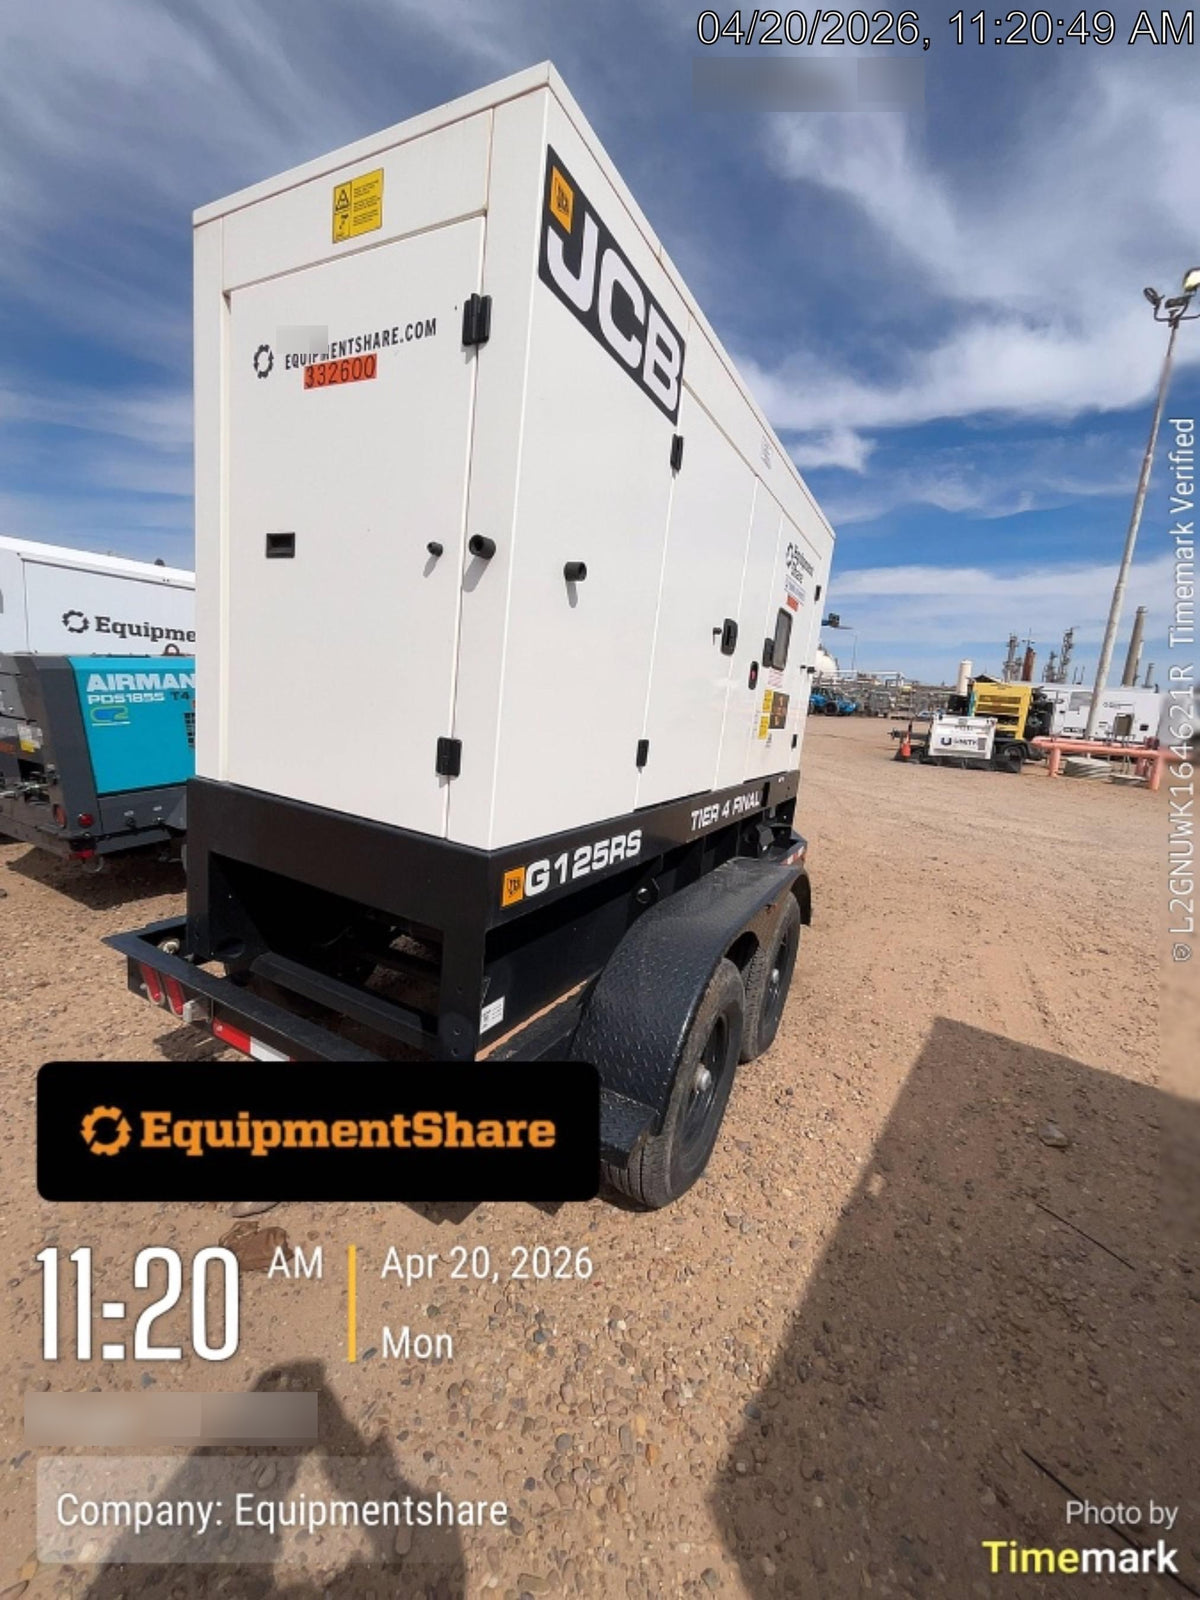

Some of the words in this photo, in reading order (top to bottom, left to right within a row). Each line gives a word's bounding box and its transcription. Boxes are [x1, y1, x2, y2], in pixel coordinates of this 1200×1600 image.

[546, 210, 682, 412] JCB
[305, 355, 376, 388] 332600
[86, 673, 196, 692] AIRMAN
[691, 803, 720, 831] TIER
[722, 799, 731, 818] 4
[732, 791, 760, 815] FINAL
[525, 829, 642, 897] G125RS
